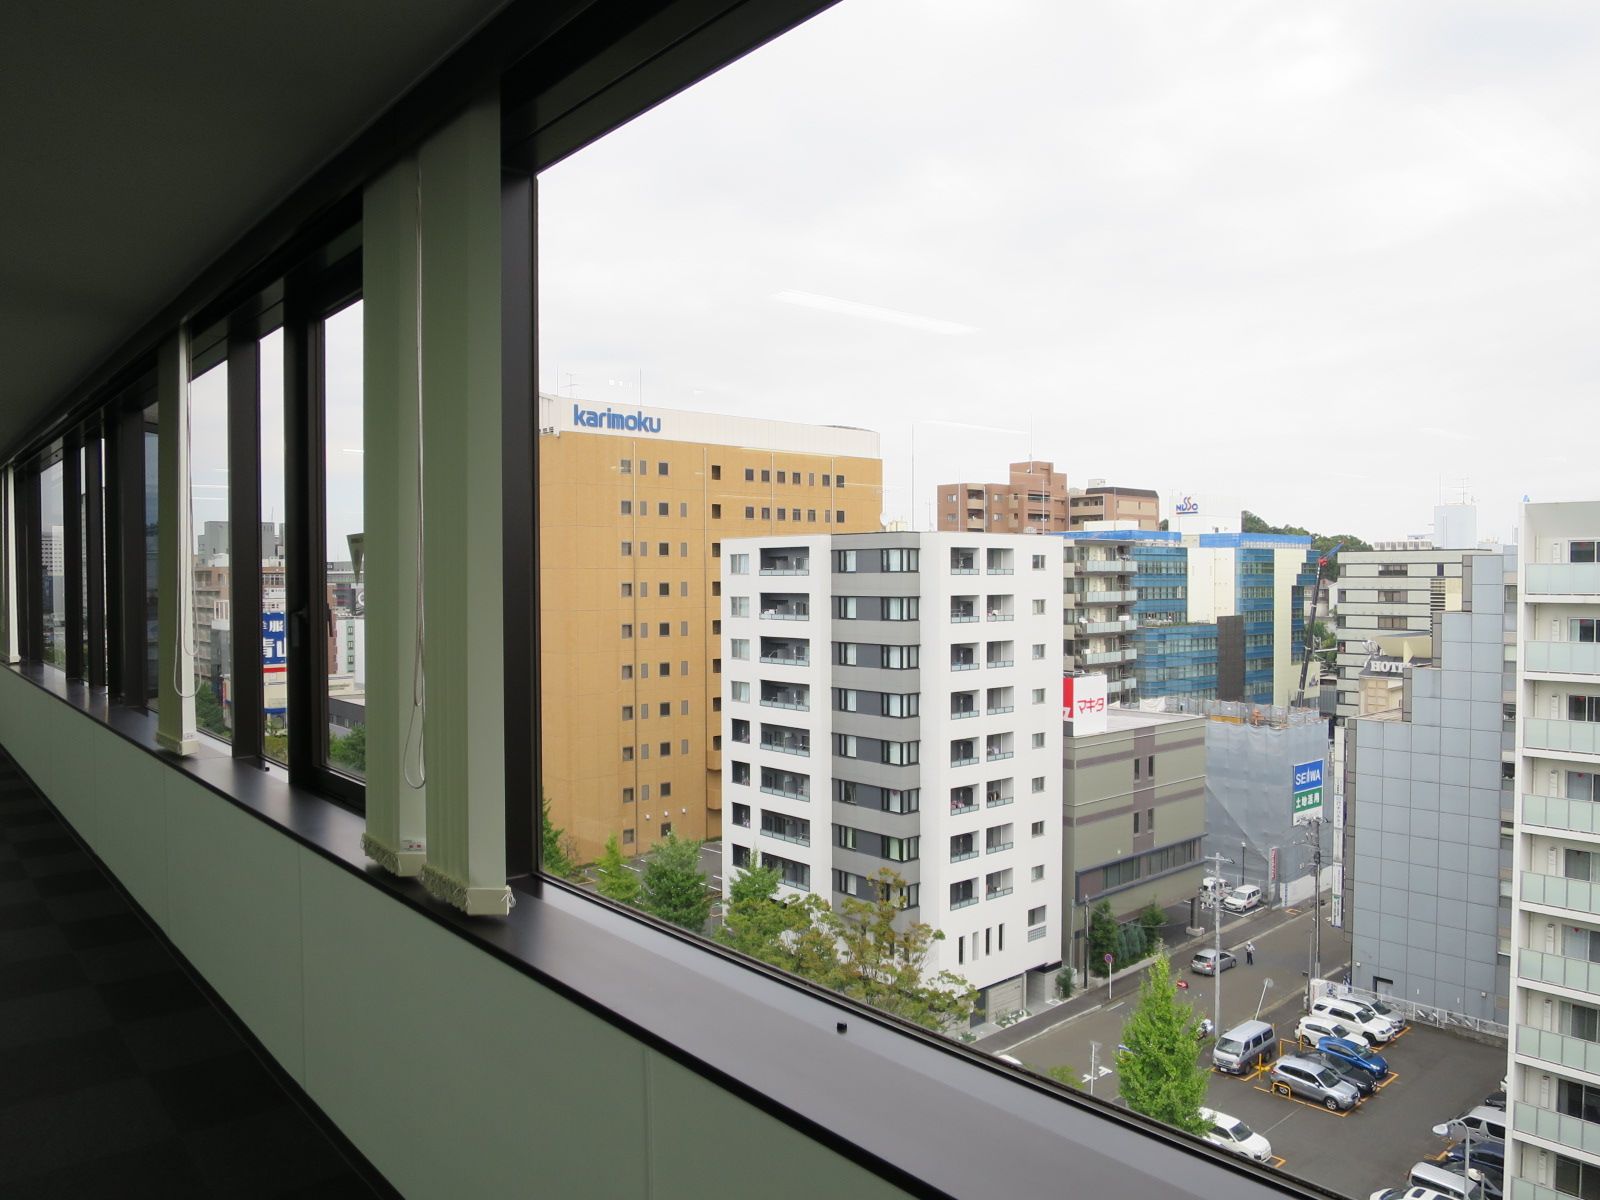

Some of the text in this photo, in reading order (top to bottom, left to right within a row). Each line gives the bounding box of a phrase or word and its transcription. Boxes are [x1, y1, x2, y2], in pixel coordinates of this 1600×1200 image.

[573, 403, 662, 433] karimoku
[1077, 697, 1105, 714] マキタ
[1295, 767, 1321, 786] SEIWA
[1295, 792, 1320, 809] 土地活用
